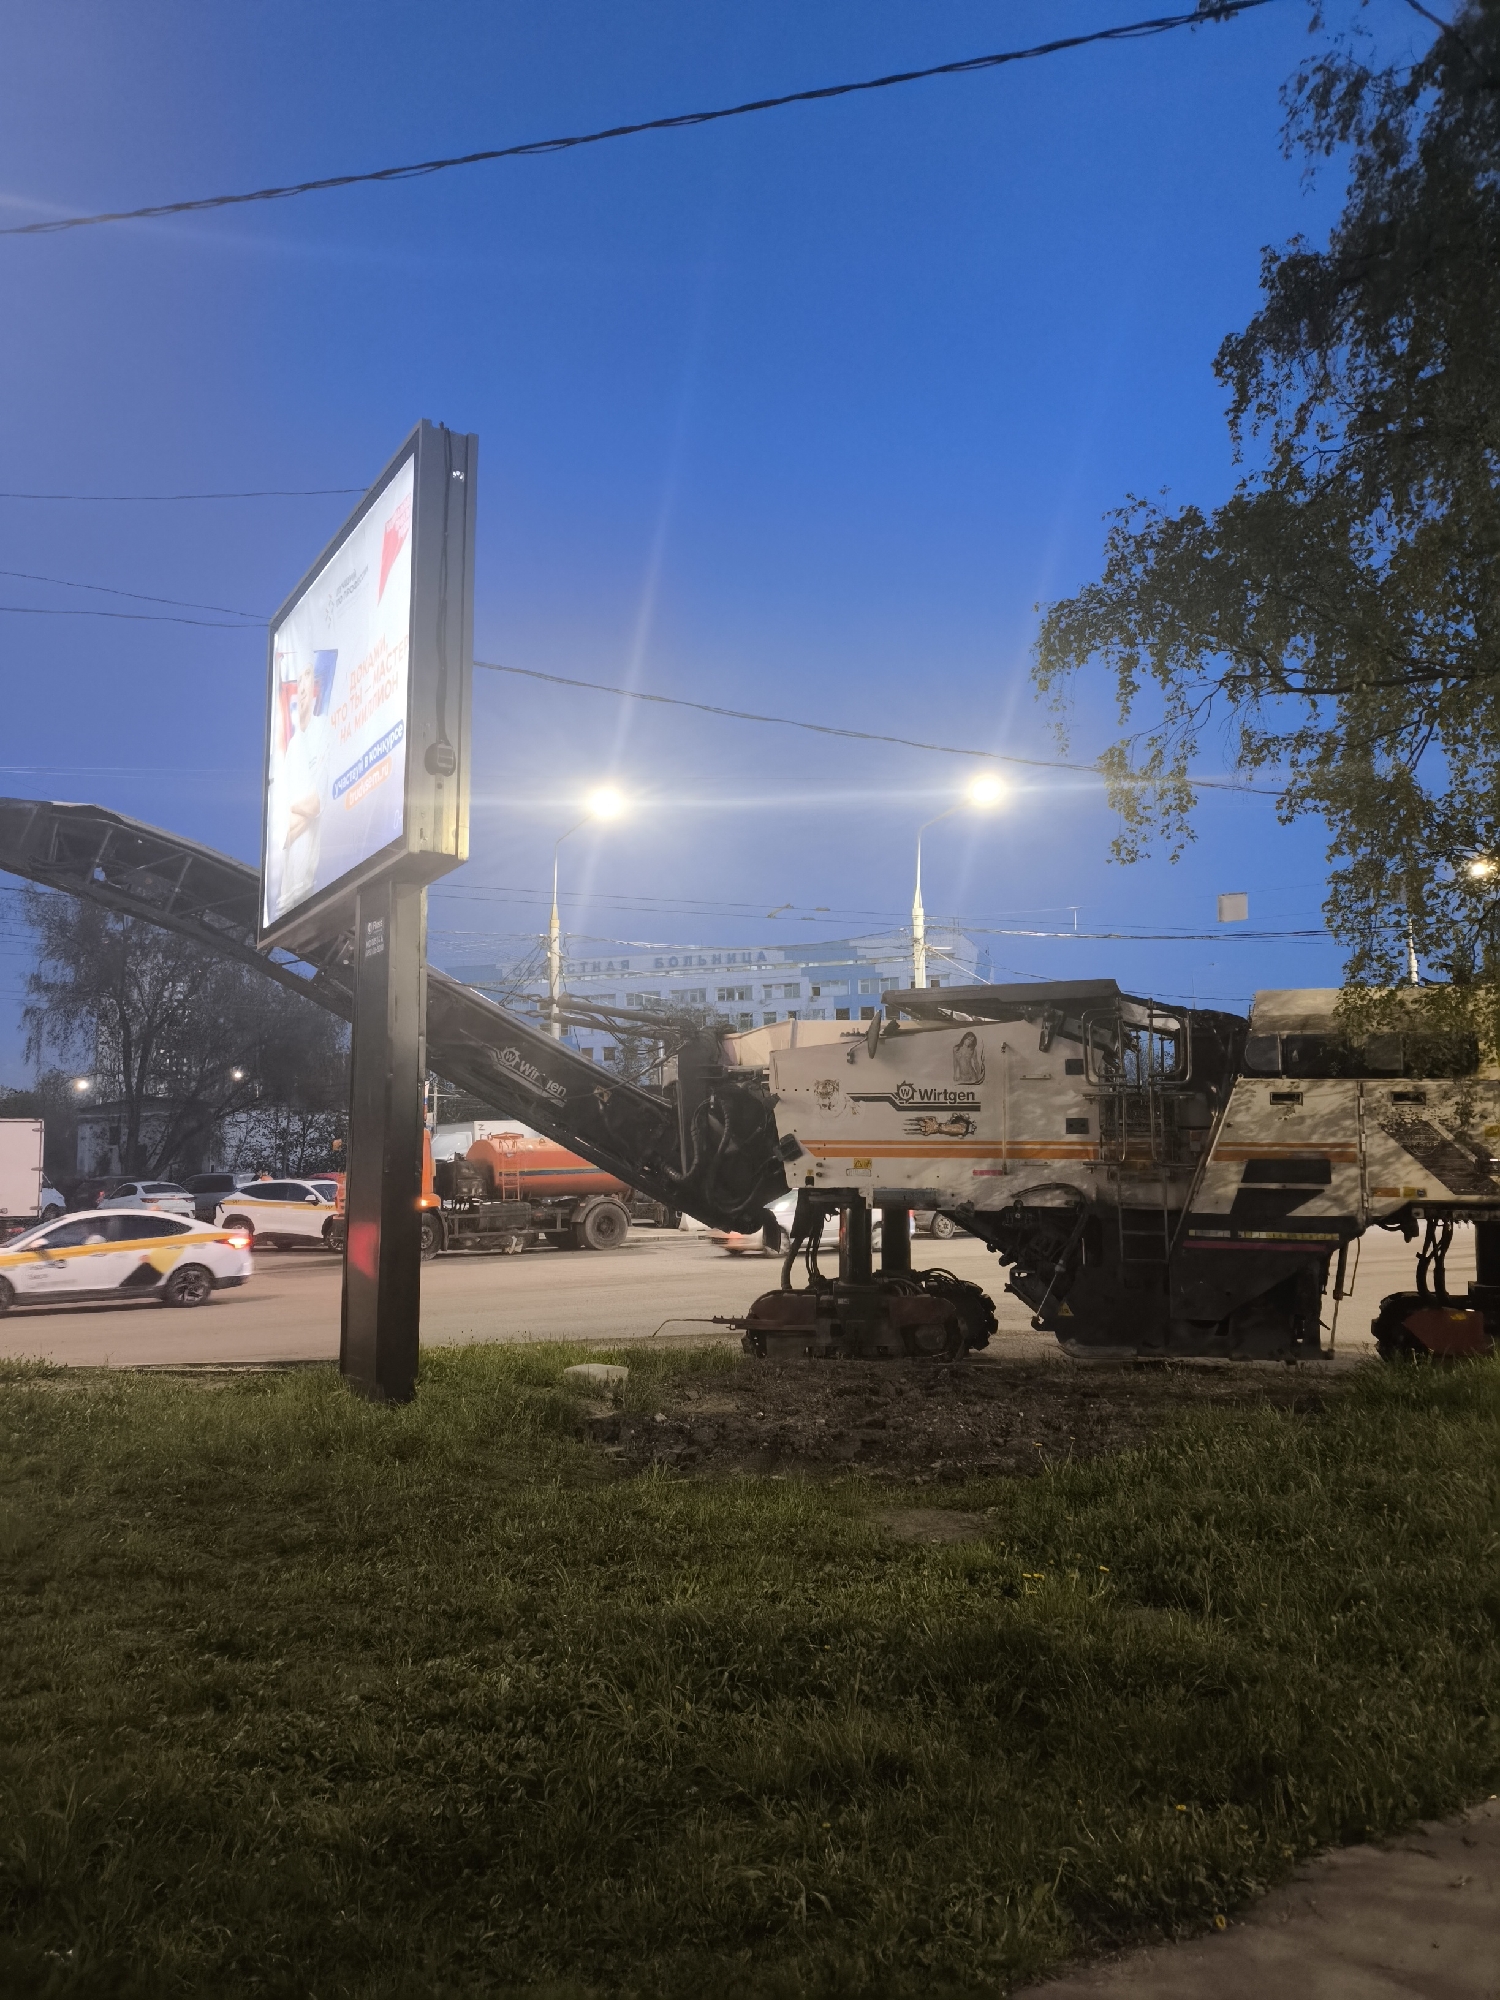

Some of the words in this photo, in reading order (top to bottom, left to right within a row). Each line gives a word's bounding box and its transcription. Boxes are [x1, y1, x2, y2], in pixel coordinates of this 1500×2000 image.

[331, 702, 347, 729] ЧТО
[350, 686, 362, 713] ТЫ
[373, 634, 409, 688] МАСТЕР
[340, 722, 352, 745] НА
[354, 671, 399, 732] МИЛЛИОН
[334, 757, 363, 798] участвуй
[364, 755, 369, 769] в
[369, 724, 403, 763] конкурсе
[349, 763, 389, 806] trudvsem.ru
[653, 950, 767, 969] БОЛЬНИЦА
[520, 1060, 567, 1097] Wiren
[900, 1088, 911, 1096] W
[918, 1088, 975, 1104] Wirtgen
